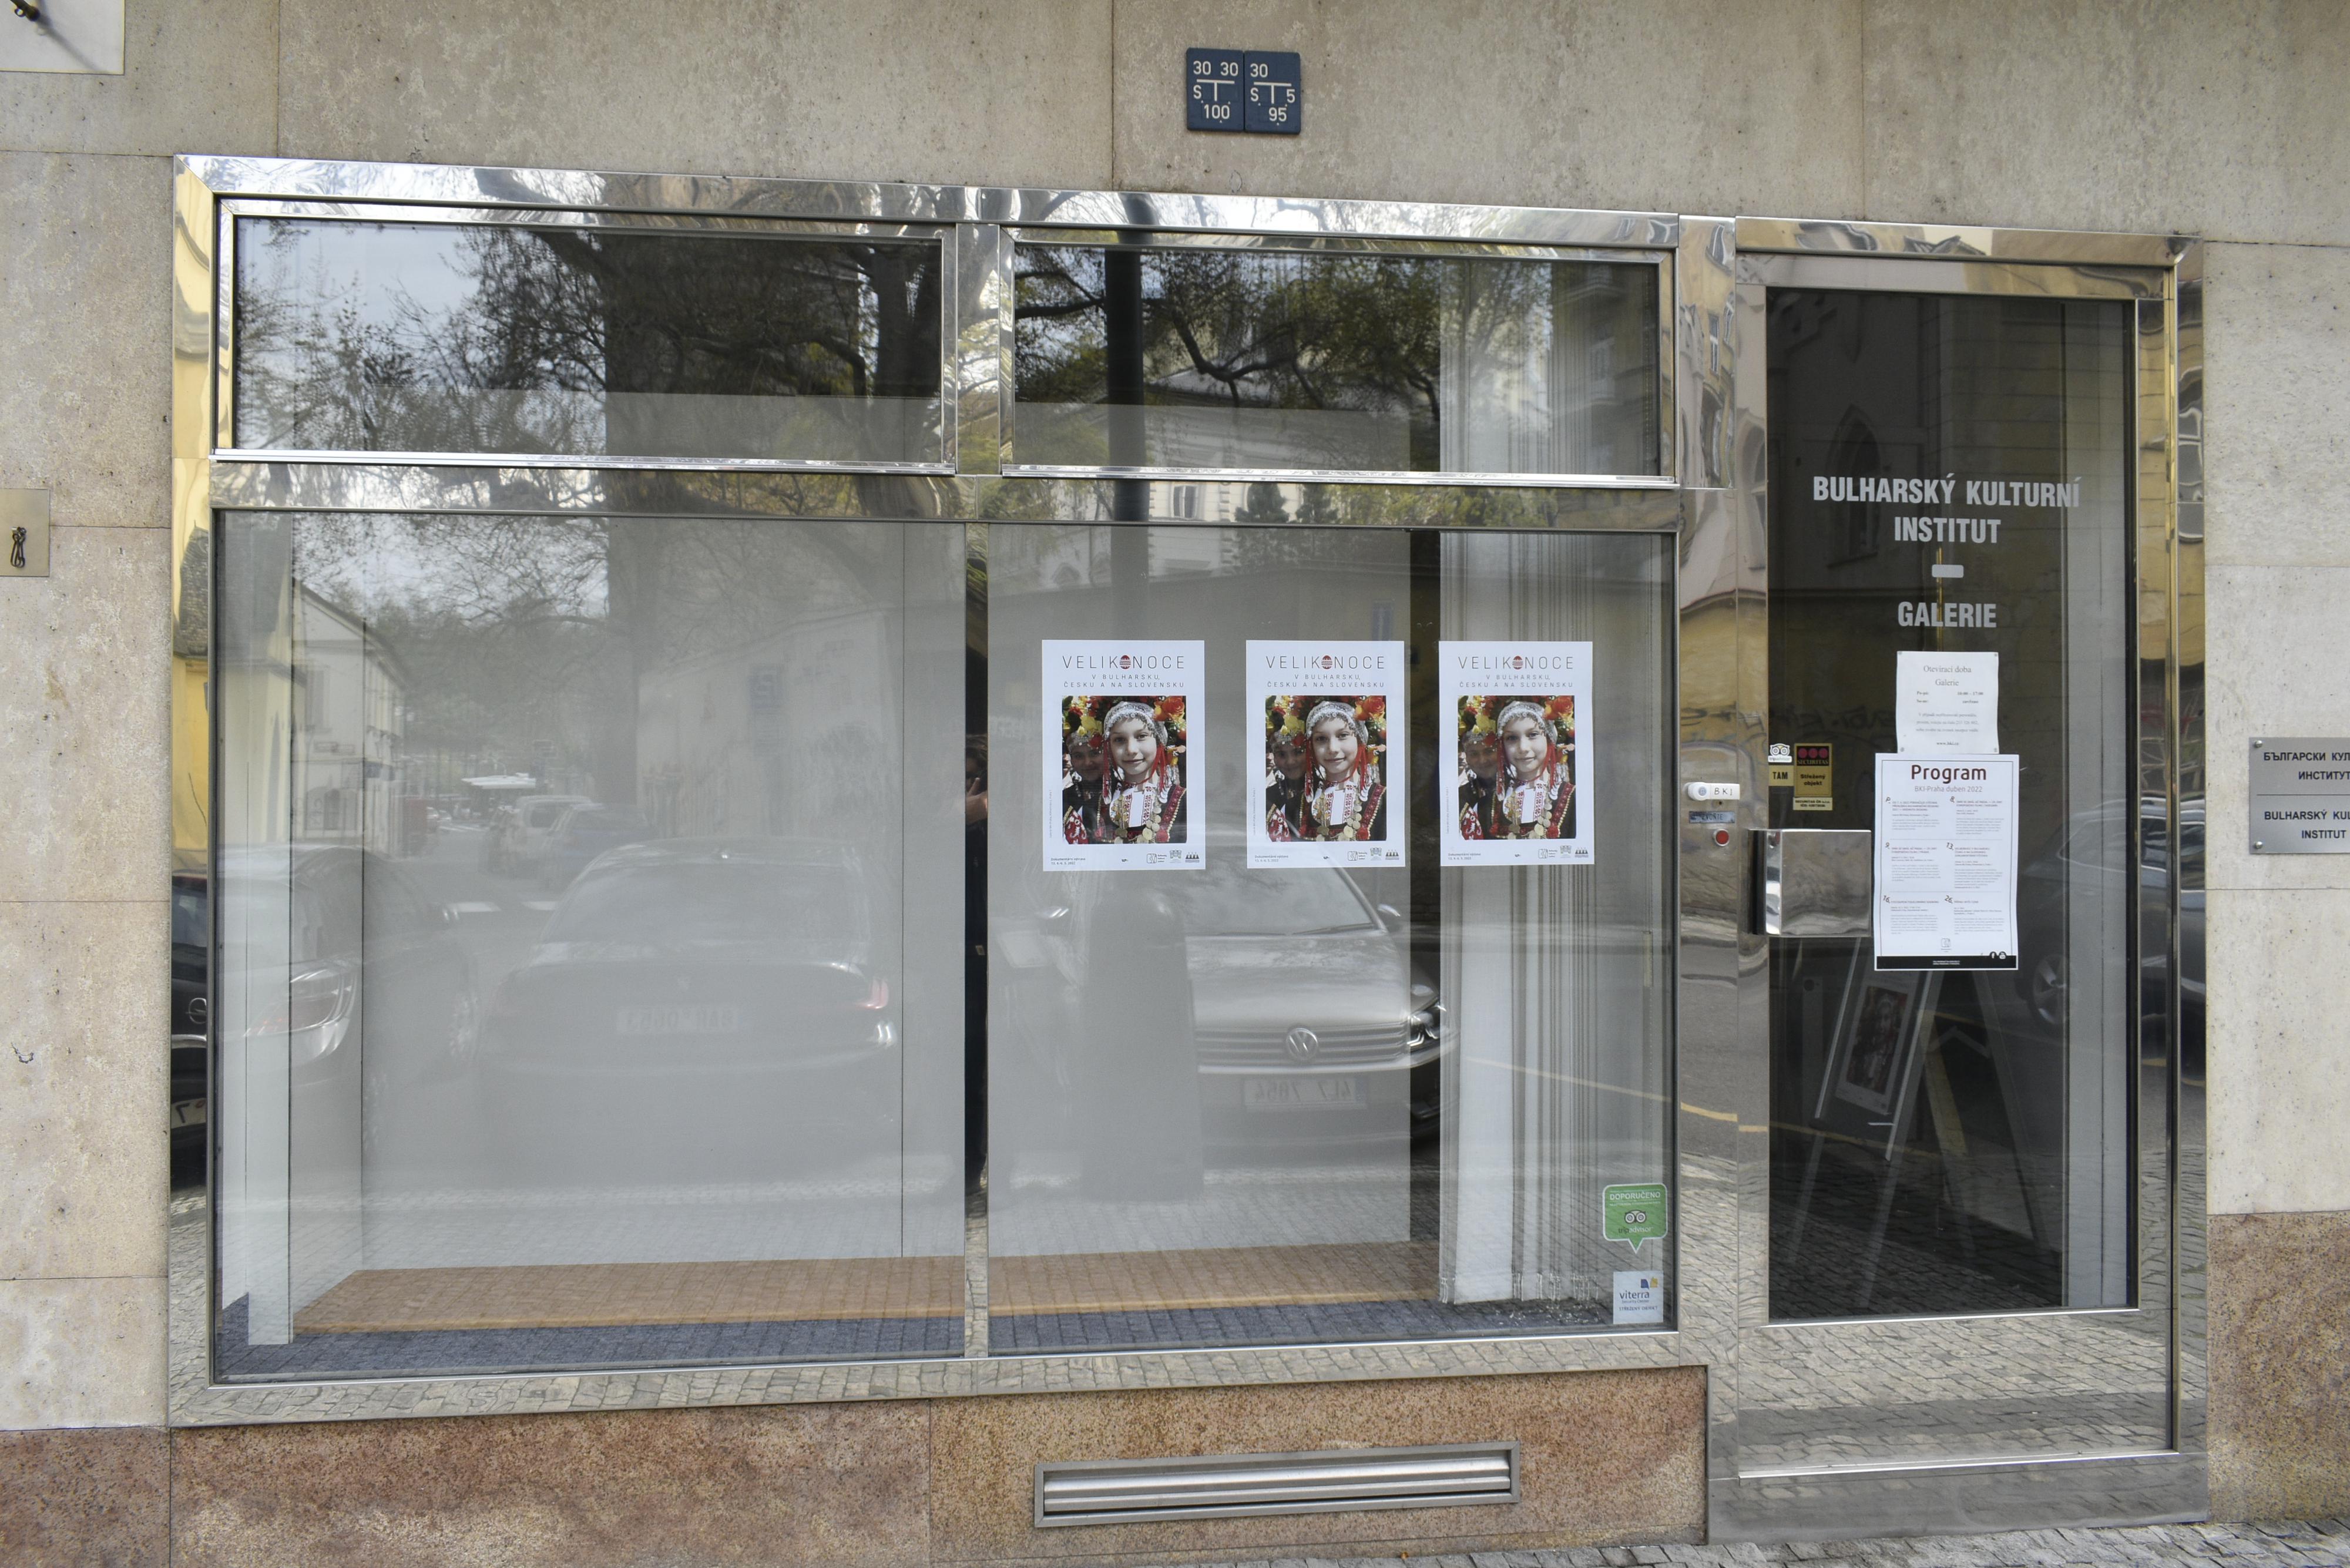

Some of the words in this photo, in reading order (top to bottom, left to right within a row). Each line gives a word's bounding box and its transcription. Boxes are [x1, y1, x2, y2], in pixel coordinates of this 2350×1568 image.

[1193, 61, 1211, 75] 30
[1220, 62, 1238, 76] 30
[1250, 63, 1268, 78] 30
[1193, 85, 1202, 99] S
[1250, 88, 1258, 102] S
[1287, 89, 1295, 103] 5
[1204, 104, 1230, 120] 100
[1268, 107, 1287, 122] 95
[1813, 472, 1956, 505] BULHARSKÝ
[1966, 476, 2082, 508] KULTURNÍ
[1894, 516, 2001, 544] INSTITUT
[1898, 601, 1997, 629] GALERIE
[1955, 665, 1972, 673] doba
[1935, 678, 1960, 686] Galerie
[2264, 752, 2326, 761] БЪЛГАРСКИ
[1772, 771, 1788, 780] TAM
[1911, 764, 1987, 784] Program
[2298, 771, 2350, 780] ИНСТИТУТ
[2264, 808, 2327, 820] BULHARSKÝ
[2301, 830, 2346, 839] INSTITUT
[1610, 1190, 1661, 1200] DOPORUČENO
[1618, 1226, 1651, 1234] tripadvisor
[1619, 1290, 1650, 1299] viterra
